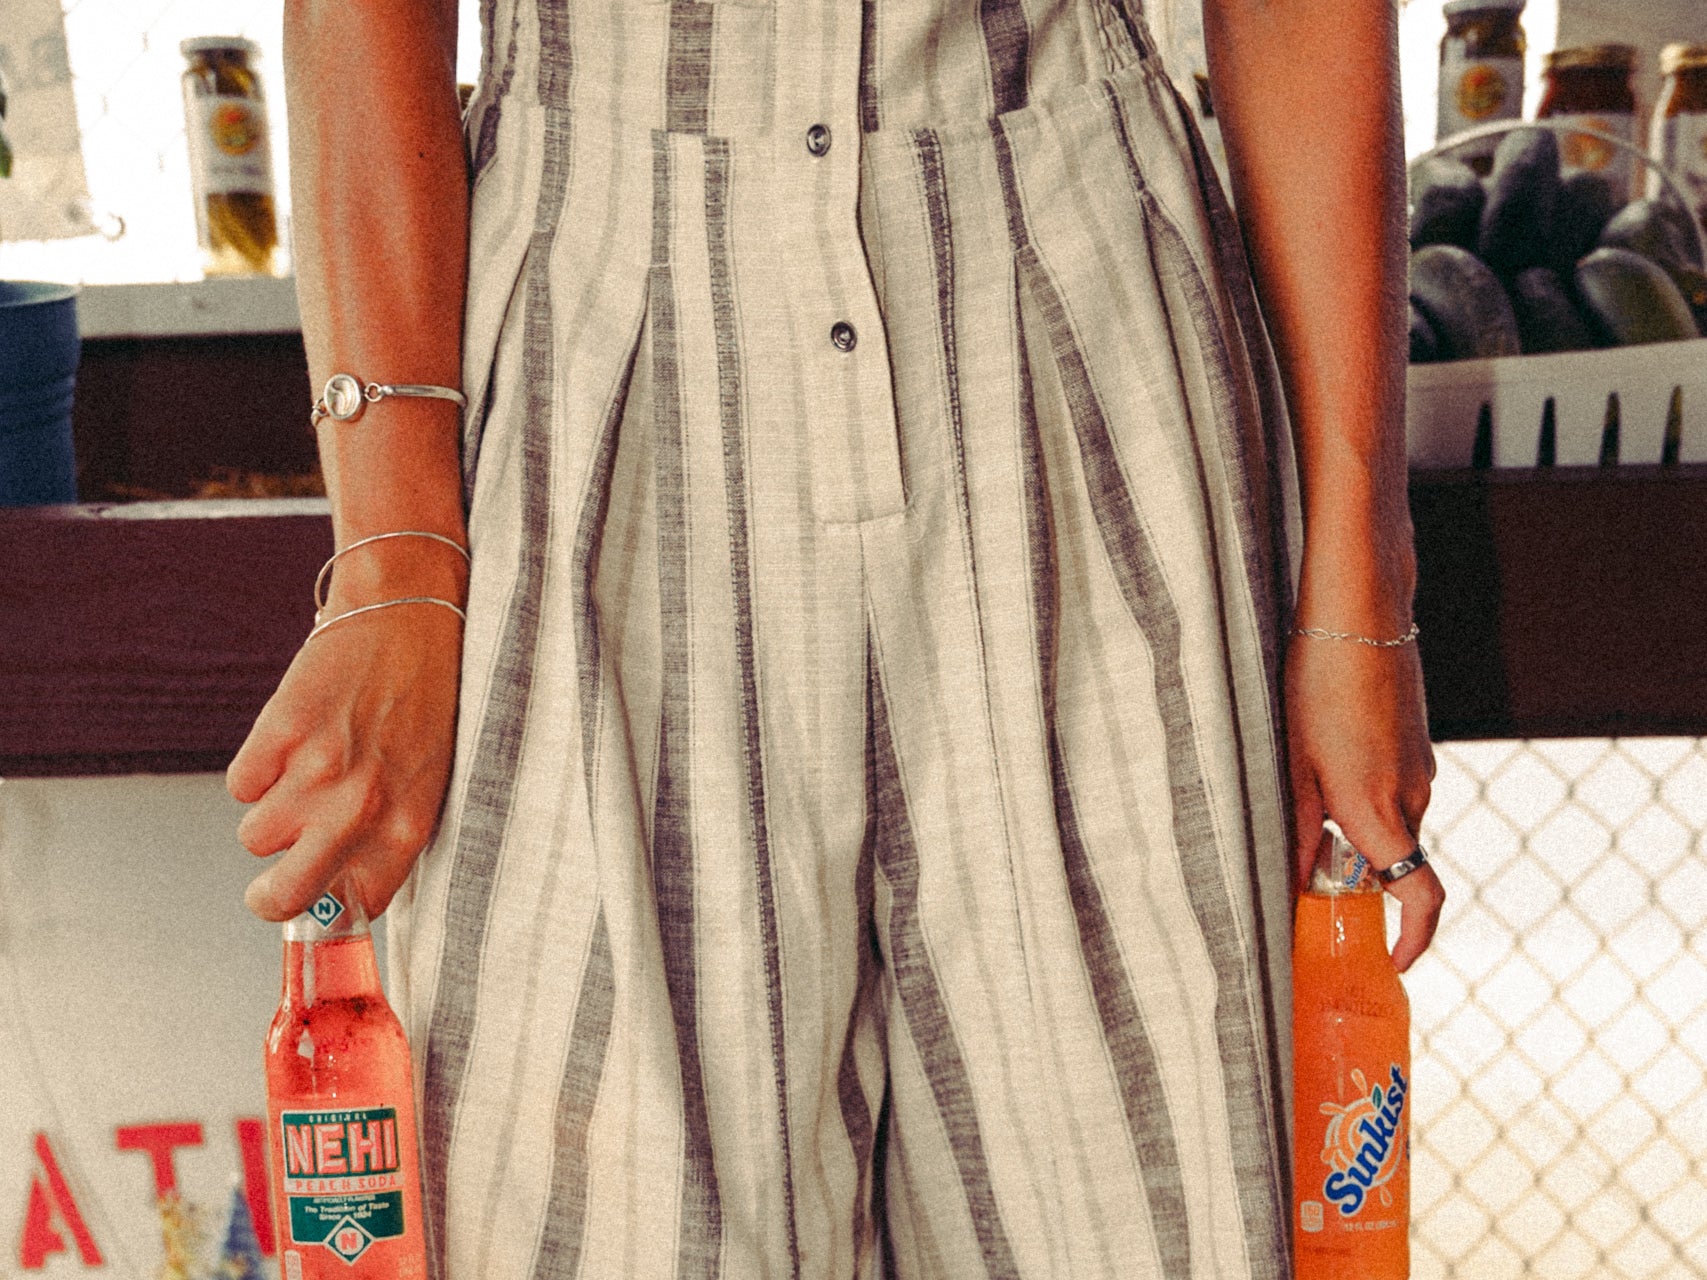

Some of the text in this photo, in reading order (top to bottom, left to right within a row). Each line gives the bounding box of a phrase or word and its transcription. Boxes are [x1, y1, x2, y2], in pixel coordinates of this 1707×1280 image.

[318, 902, 331, 915] N
[308, 1113, 367, 1124] ORIGINAL
[286, 1118, 398, 1175] NEHI
[1325, 1063, 1408, 1214] Sunkist
[295, 1175, 397, 1191] PEACH SODA
[320, 1205, 356, 1214] Tradition
[358, 1204, 367, 1212] of
[369, 1202, 390, 1210] Taste
[341, 1233, 357, 1250] N
